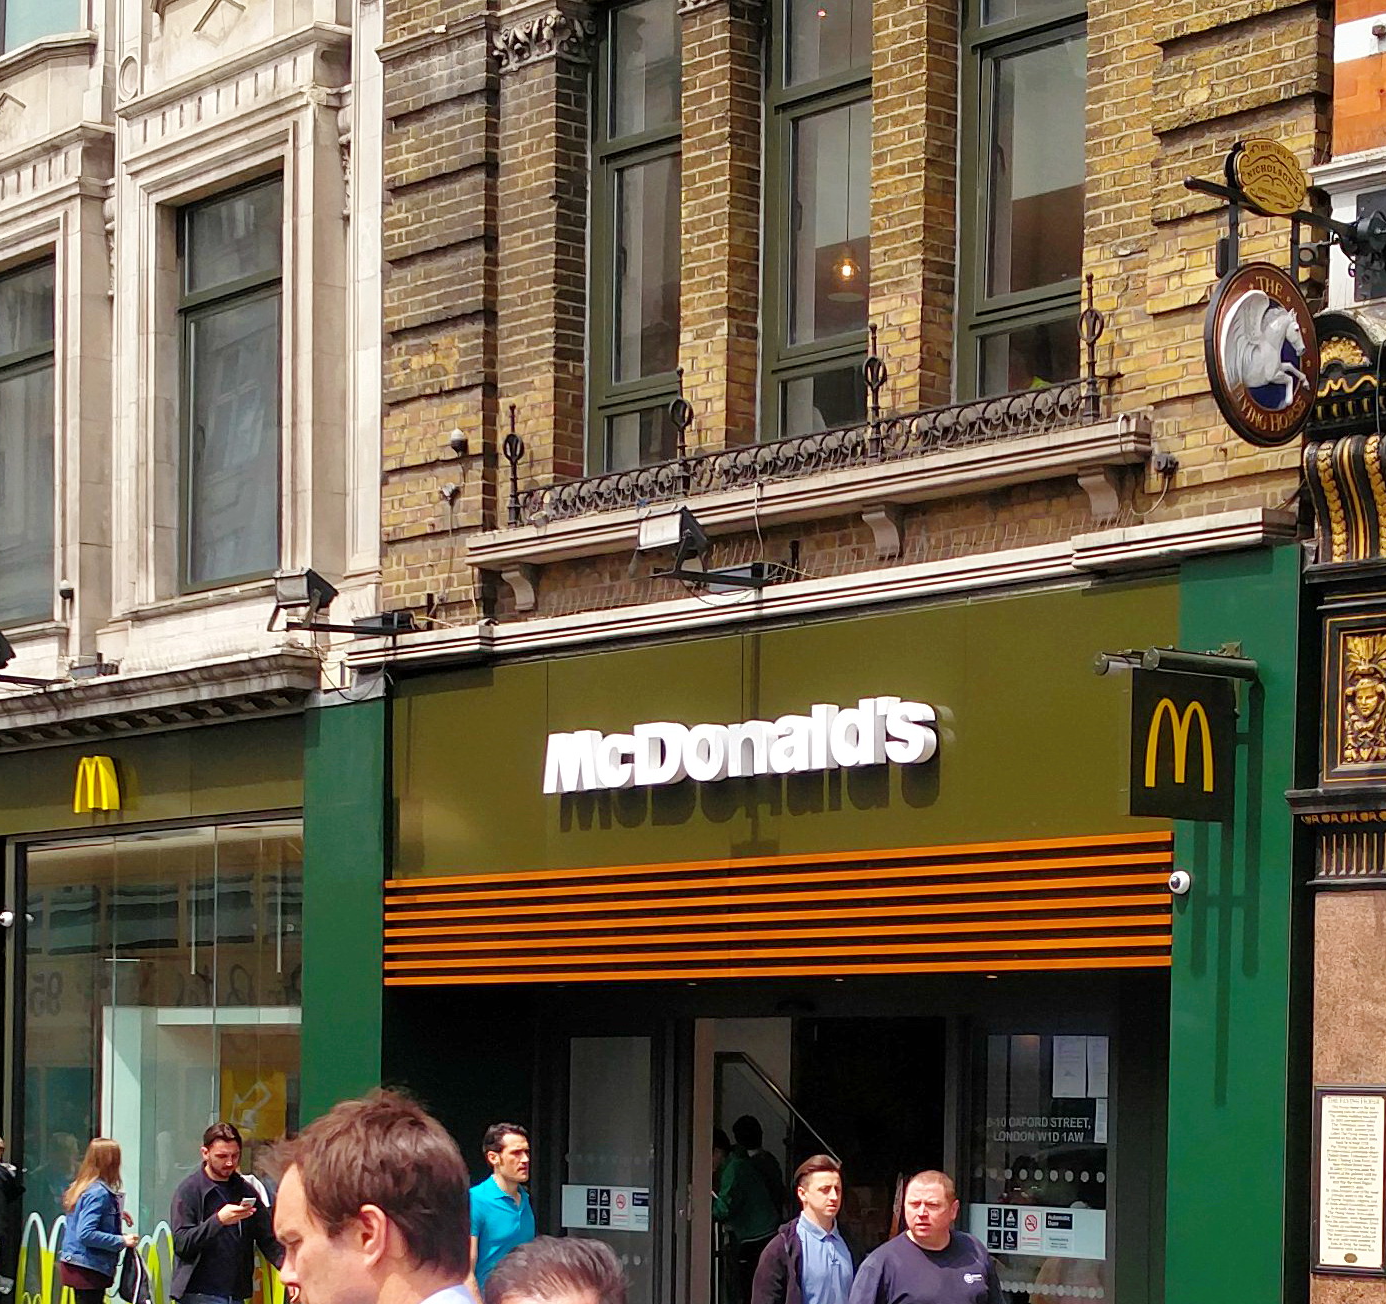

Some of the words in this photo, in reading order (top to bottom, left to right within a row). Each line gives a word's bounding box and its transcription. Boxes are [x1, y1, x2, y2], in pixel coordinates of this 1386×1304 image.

[1255, 276, 1284, 299] THE
[1269, 396, 1306, 432] HORSE
[542, 696, 937, 795] McDonald's
[1009, 1117, 1049, 1128] OXFORD
[1050, 1117, 1091, 1130] STREET,
[994, 1131, 1037, 1142] LONDON
[1038, 1132, 1060, 1142] W1D
[1061, 1132, 1084, 1143] 1AW
